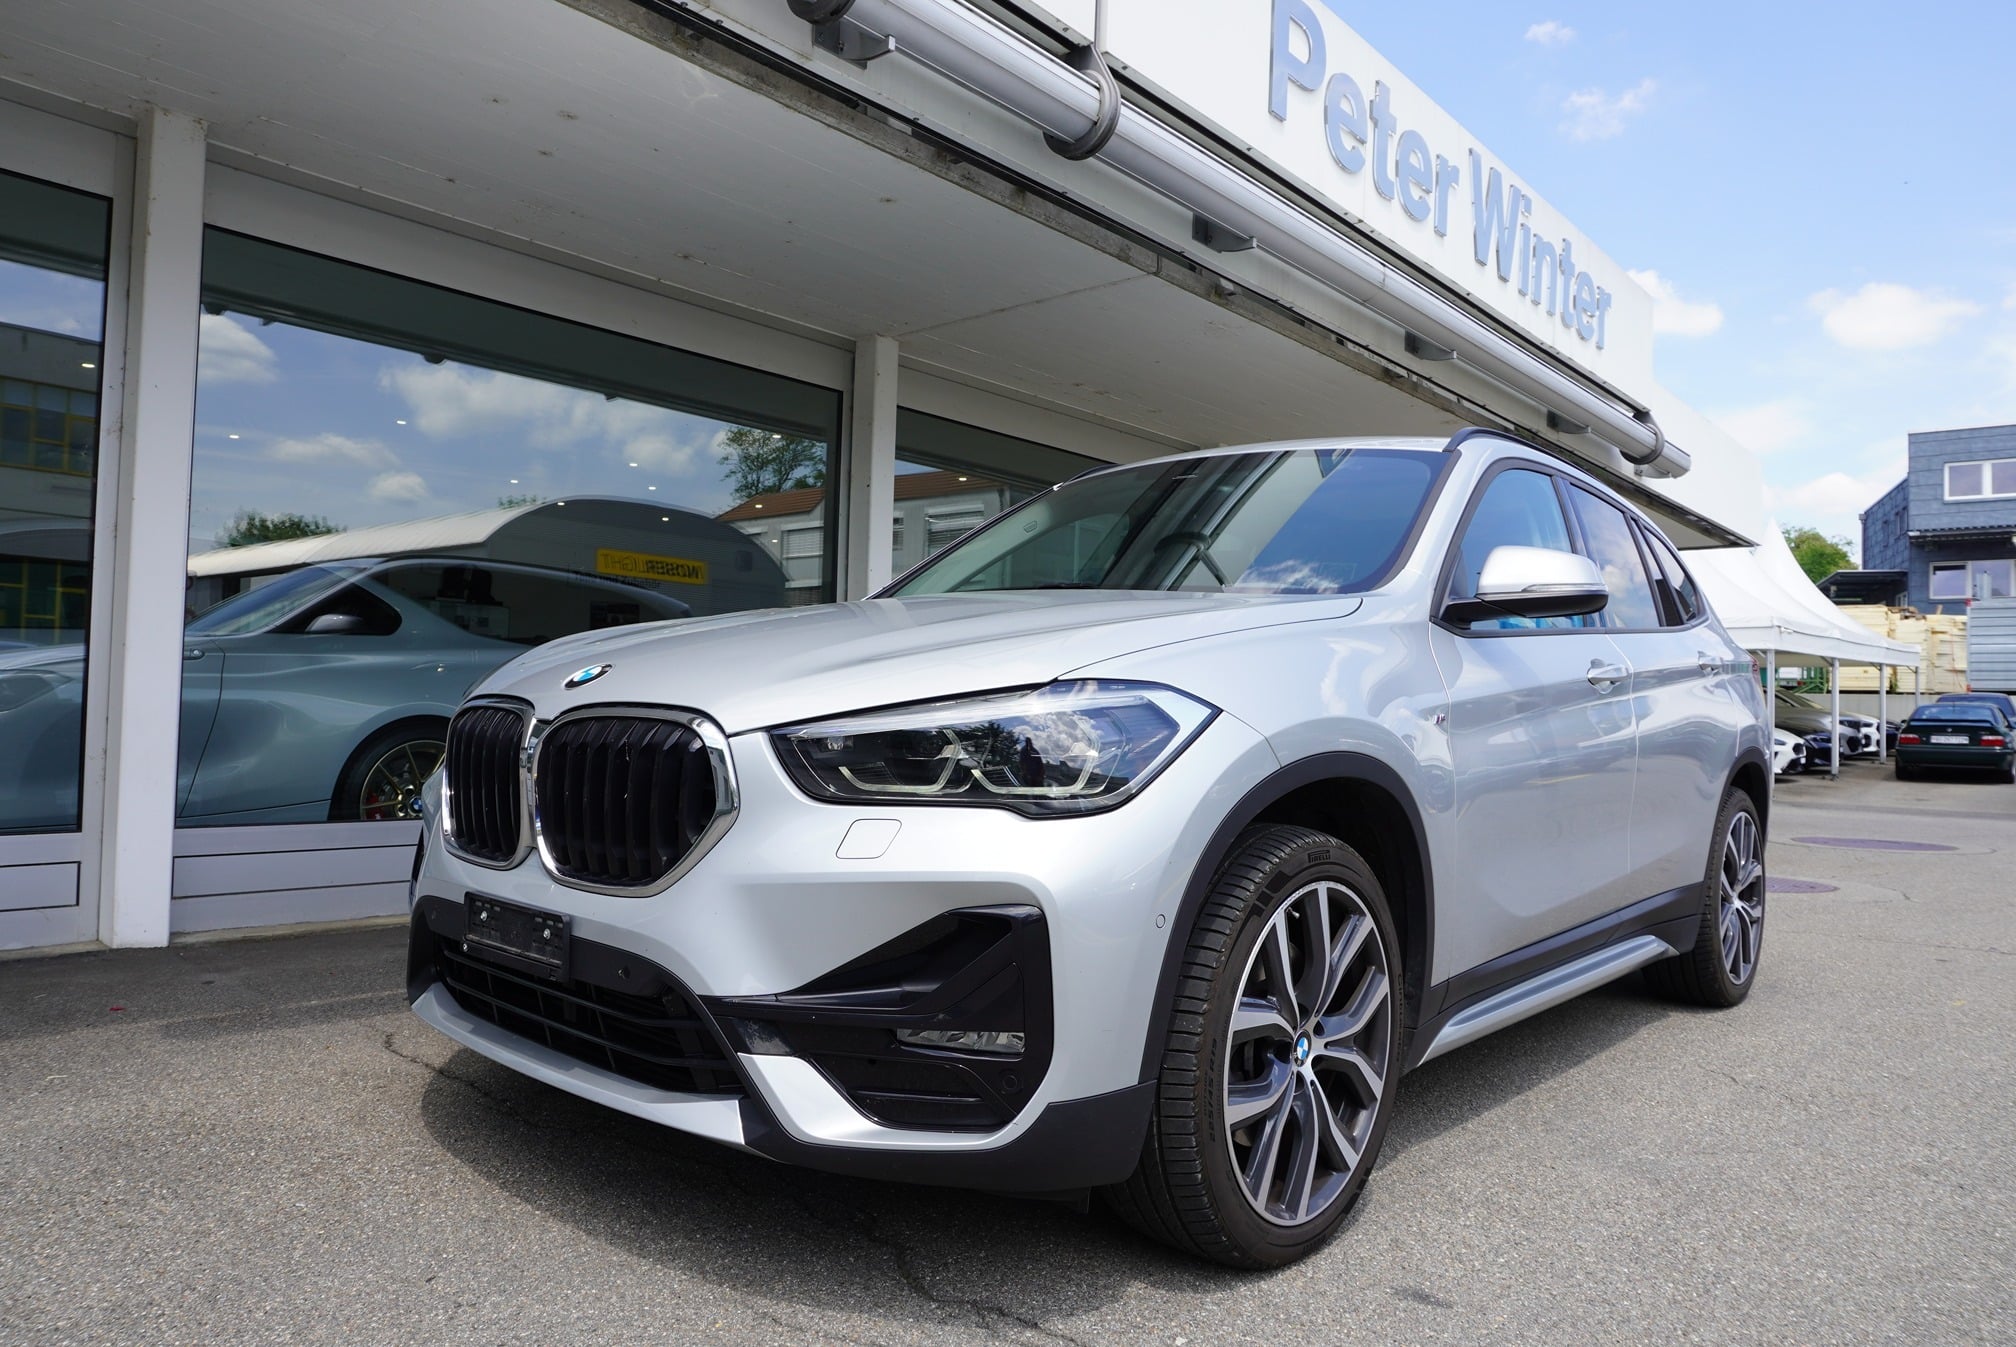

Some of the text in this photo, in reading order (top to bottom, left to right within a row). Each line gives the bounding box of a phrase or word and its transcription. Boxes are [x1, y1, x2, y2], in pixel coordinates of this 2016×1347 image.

[1268, 0, 1612, 350] Peter Winter
[1307, 849, 1331, 864] PIRELLI
